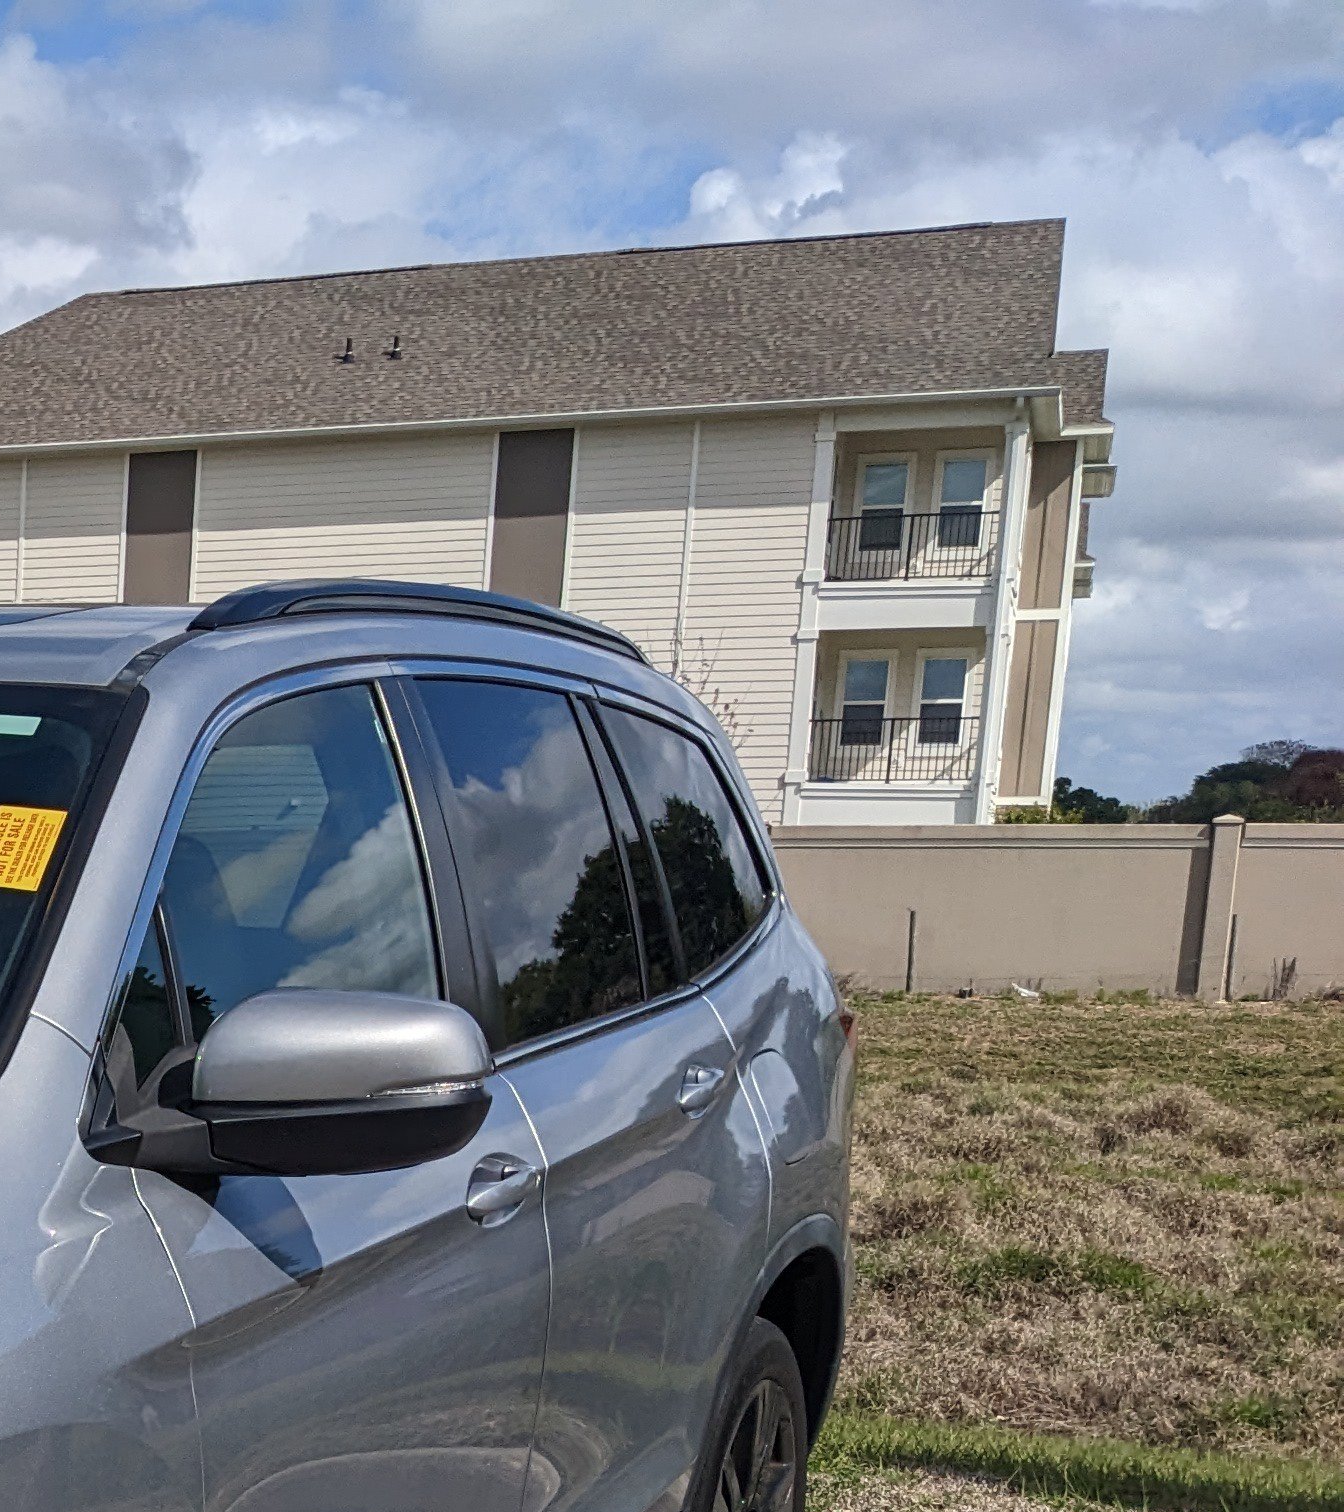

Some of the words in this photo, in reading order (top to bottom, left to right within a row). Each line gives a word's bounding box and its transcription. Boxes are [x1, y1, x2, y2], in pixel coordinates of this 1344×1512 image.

[0, 812, 12, 820] IS
[7, 817, 25, 838] SALE
[0, 840, 16, 857] FOR
